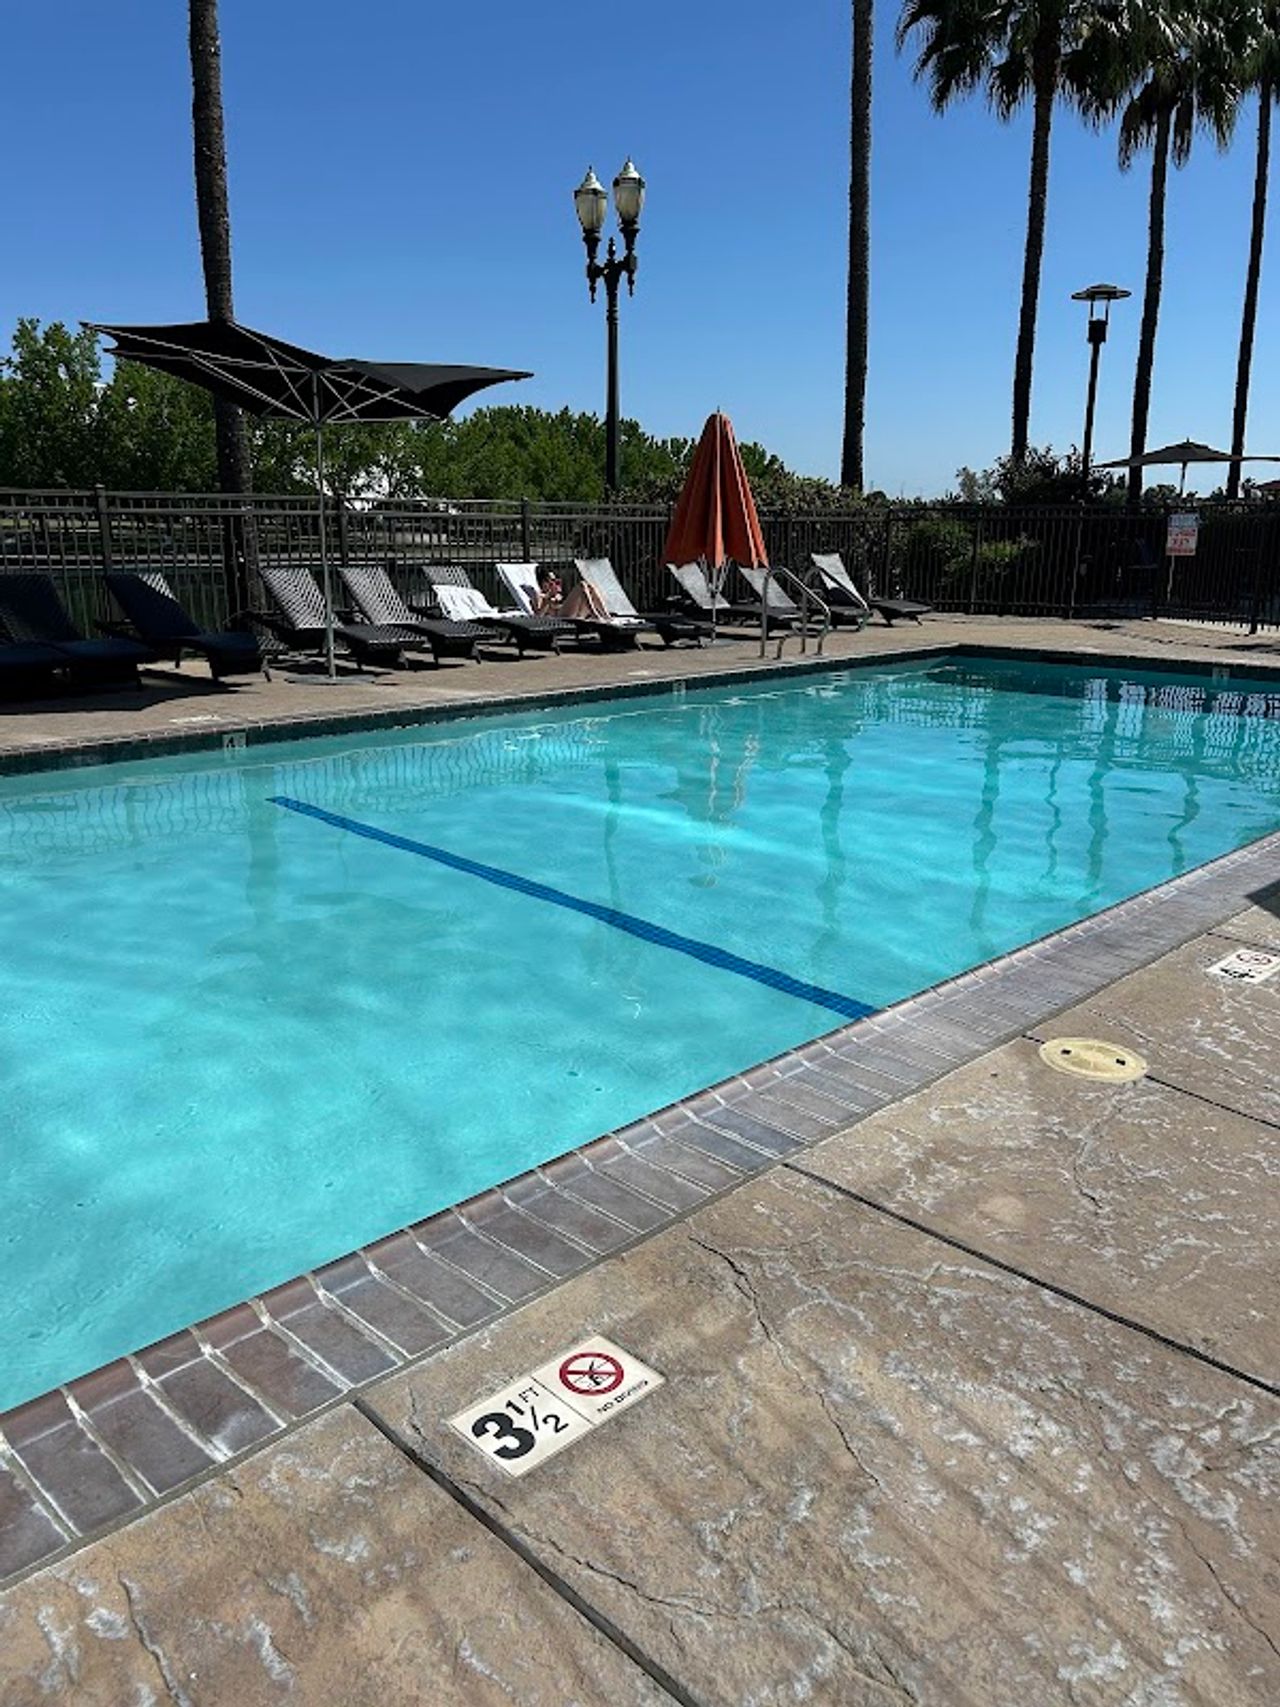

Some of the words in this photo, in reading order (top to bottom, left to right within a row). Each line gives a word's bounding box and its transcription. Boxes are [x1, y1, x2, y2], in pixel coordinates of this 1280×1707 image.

[471, 1412, 536, 1460] 3
[518, 1386, 540, 1403] FT
[597, 1401, 614, 1414] NO
